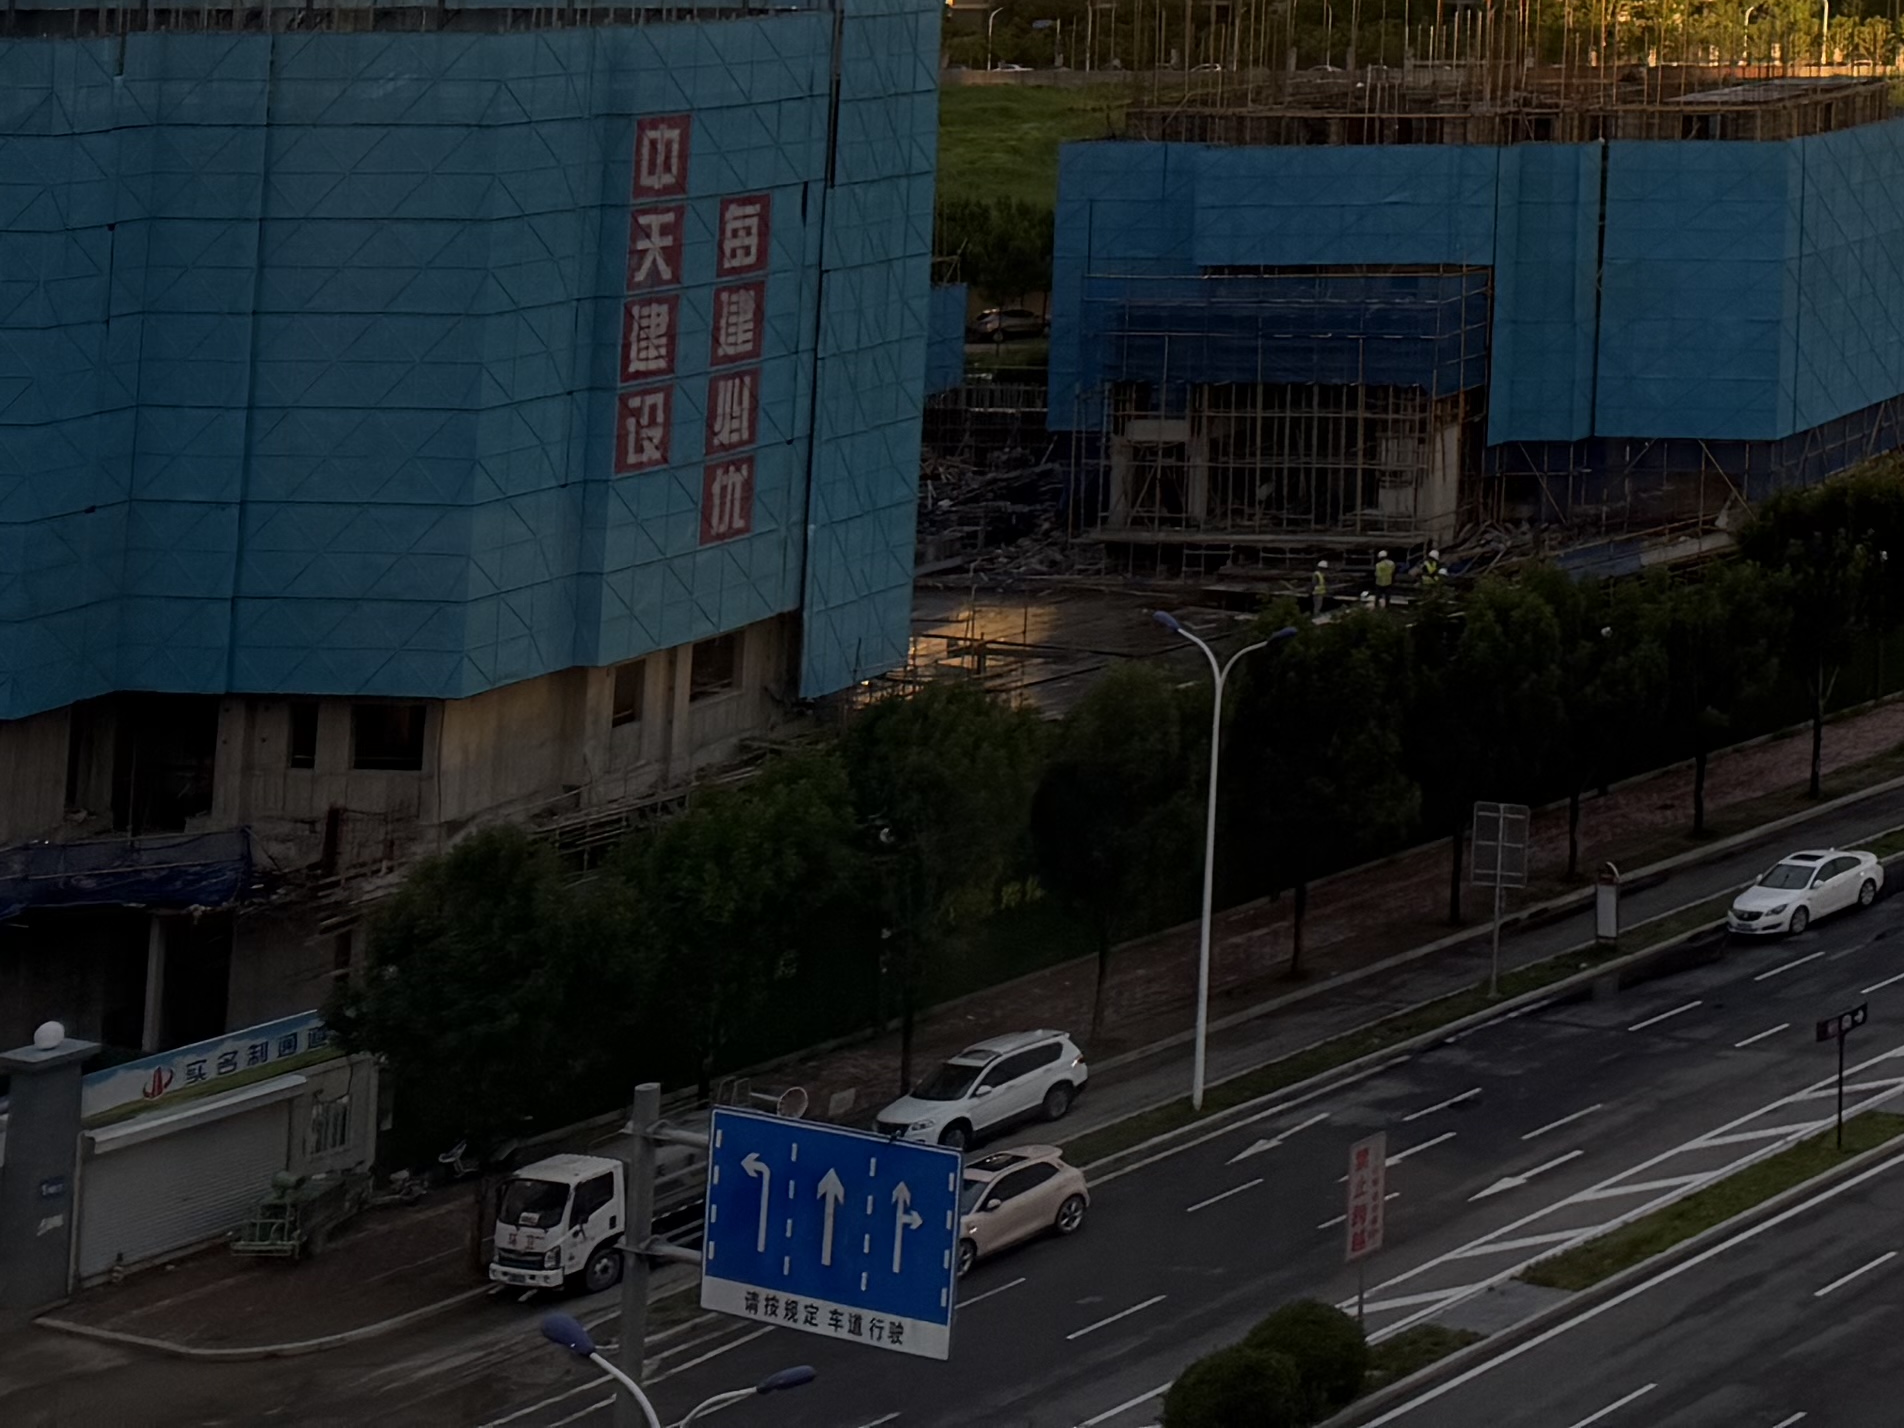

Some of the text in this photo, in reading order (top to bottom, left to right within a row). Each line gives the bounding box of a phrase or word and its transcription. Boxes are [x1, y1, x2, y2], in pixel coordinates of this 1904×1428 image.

[626, 124, 681, 464] 中天建设
[710, 203, 761, 536] 每建必优
[744, 1290, 904, 1345] 请按规定车道行驶
